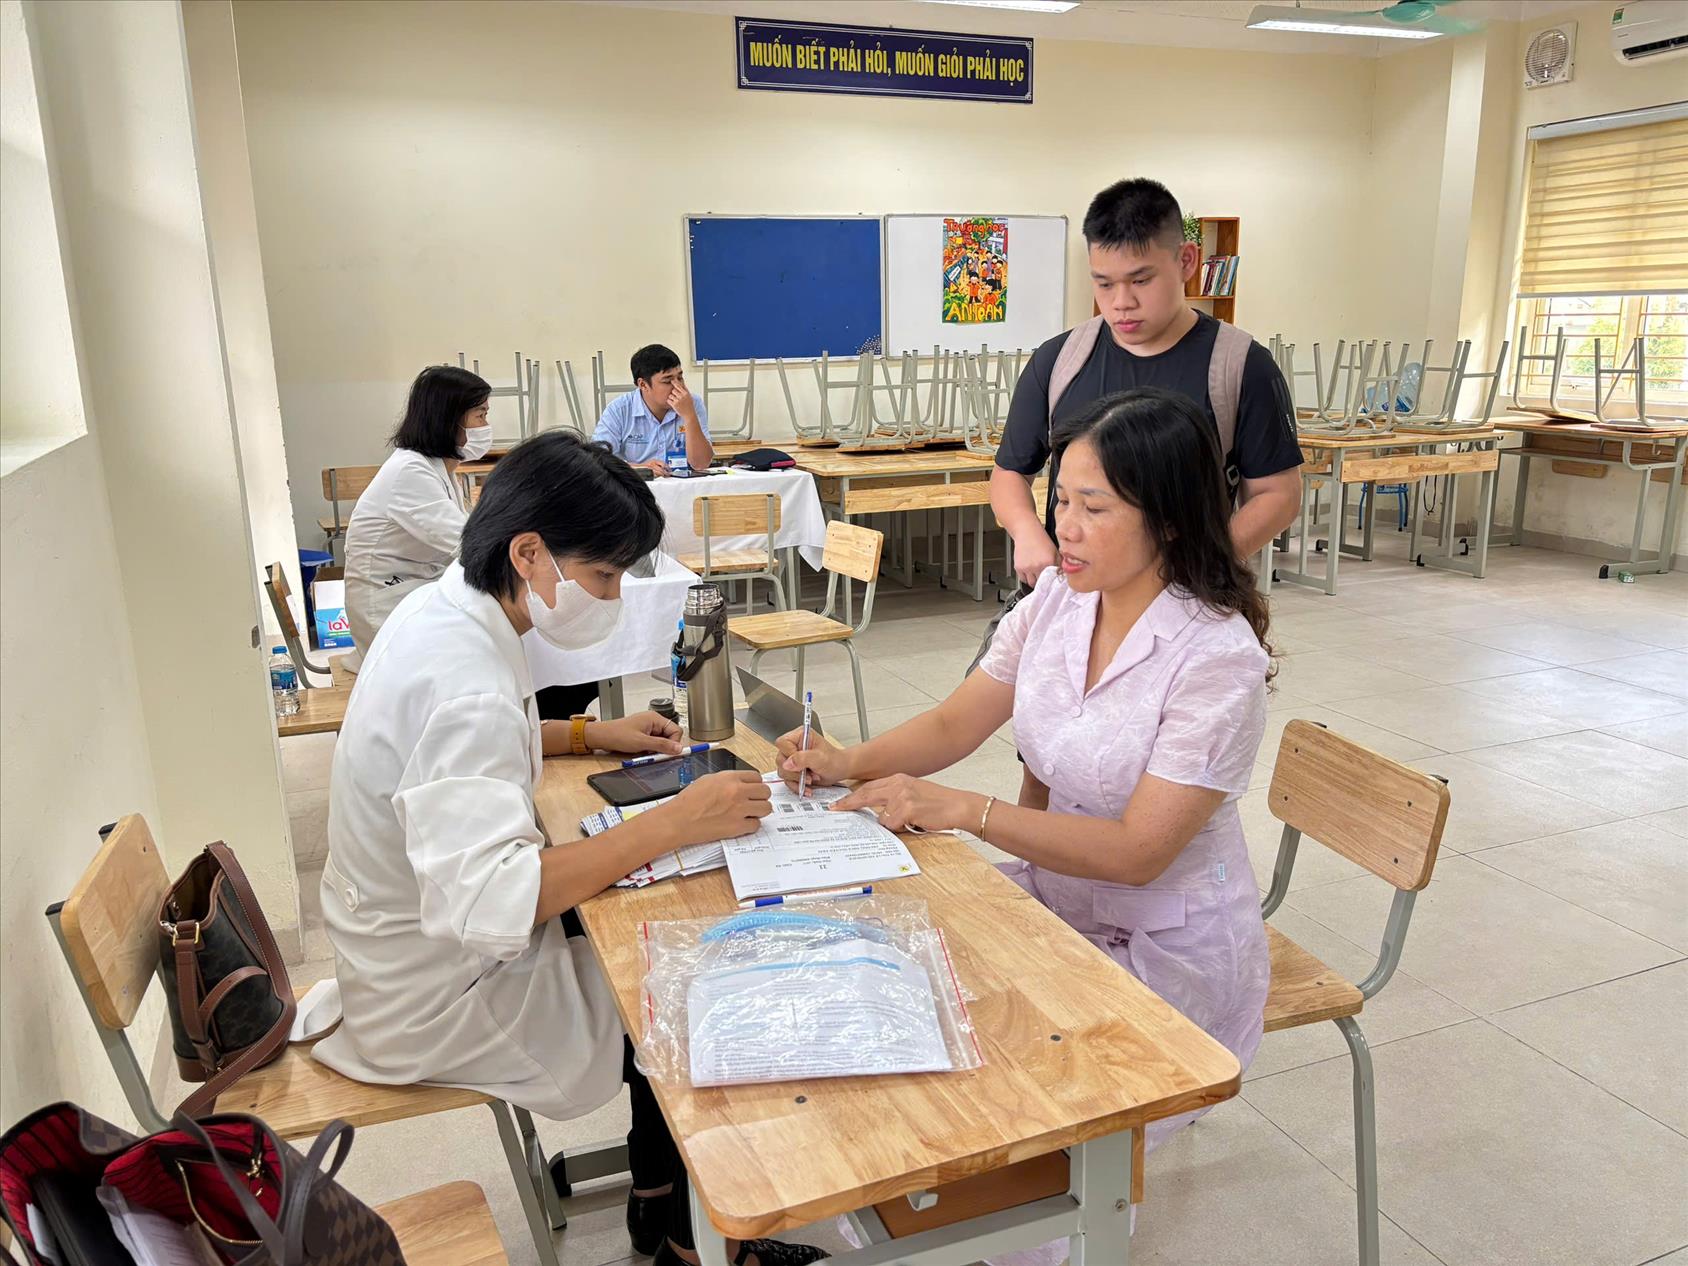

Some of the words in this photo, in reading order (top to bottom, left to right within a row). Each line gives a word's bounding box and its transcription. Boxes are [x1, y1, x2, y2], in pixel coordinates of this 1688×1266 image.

[749, 34, 793, 69] MUỐN
[796, 38, 826, 70] BIẾT
[829, 39, 861, 72] PHẢI
[865, 41, 892, 77] HỎI,
[895, 44, 934, 77] MUỐN
[938, 47, 964, 79] GIỎI
[967, 49, 997, 81] PHẢI
[999, 58, 1025, 87] HỌC
